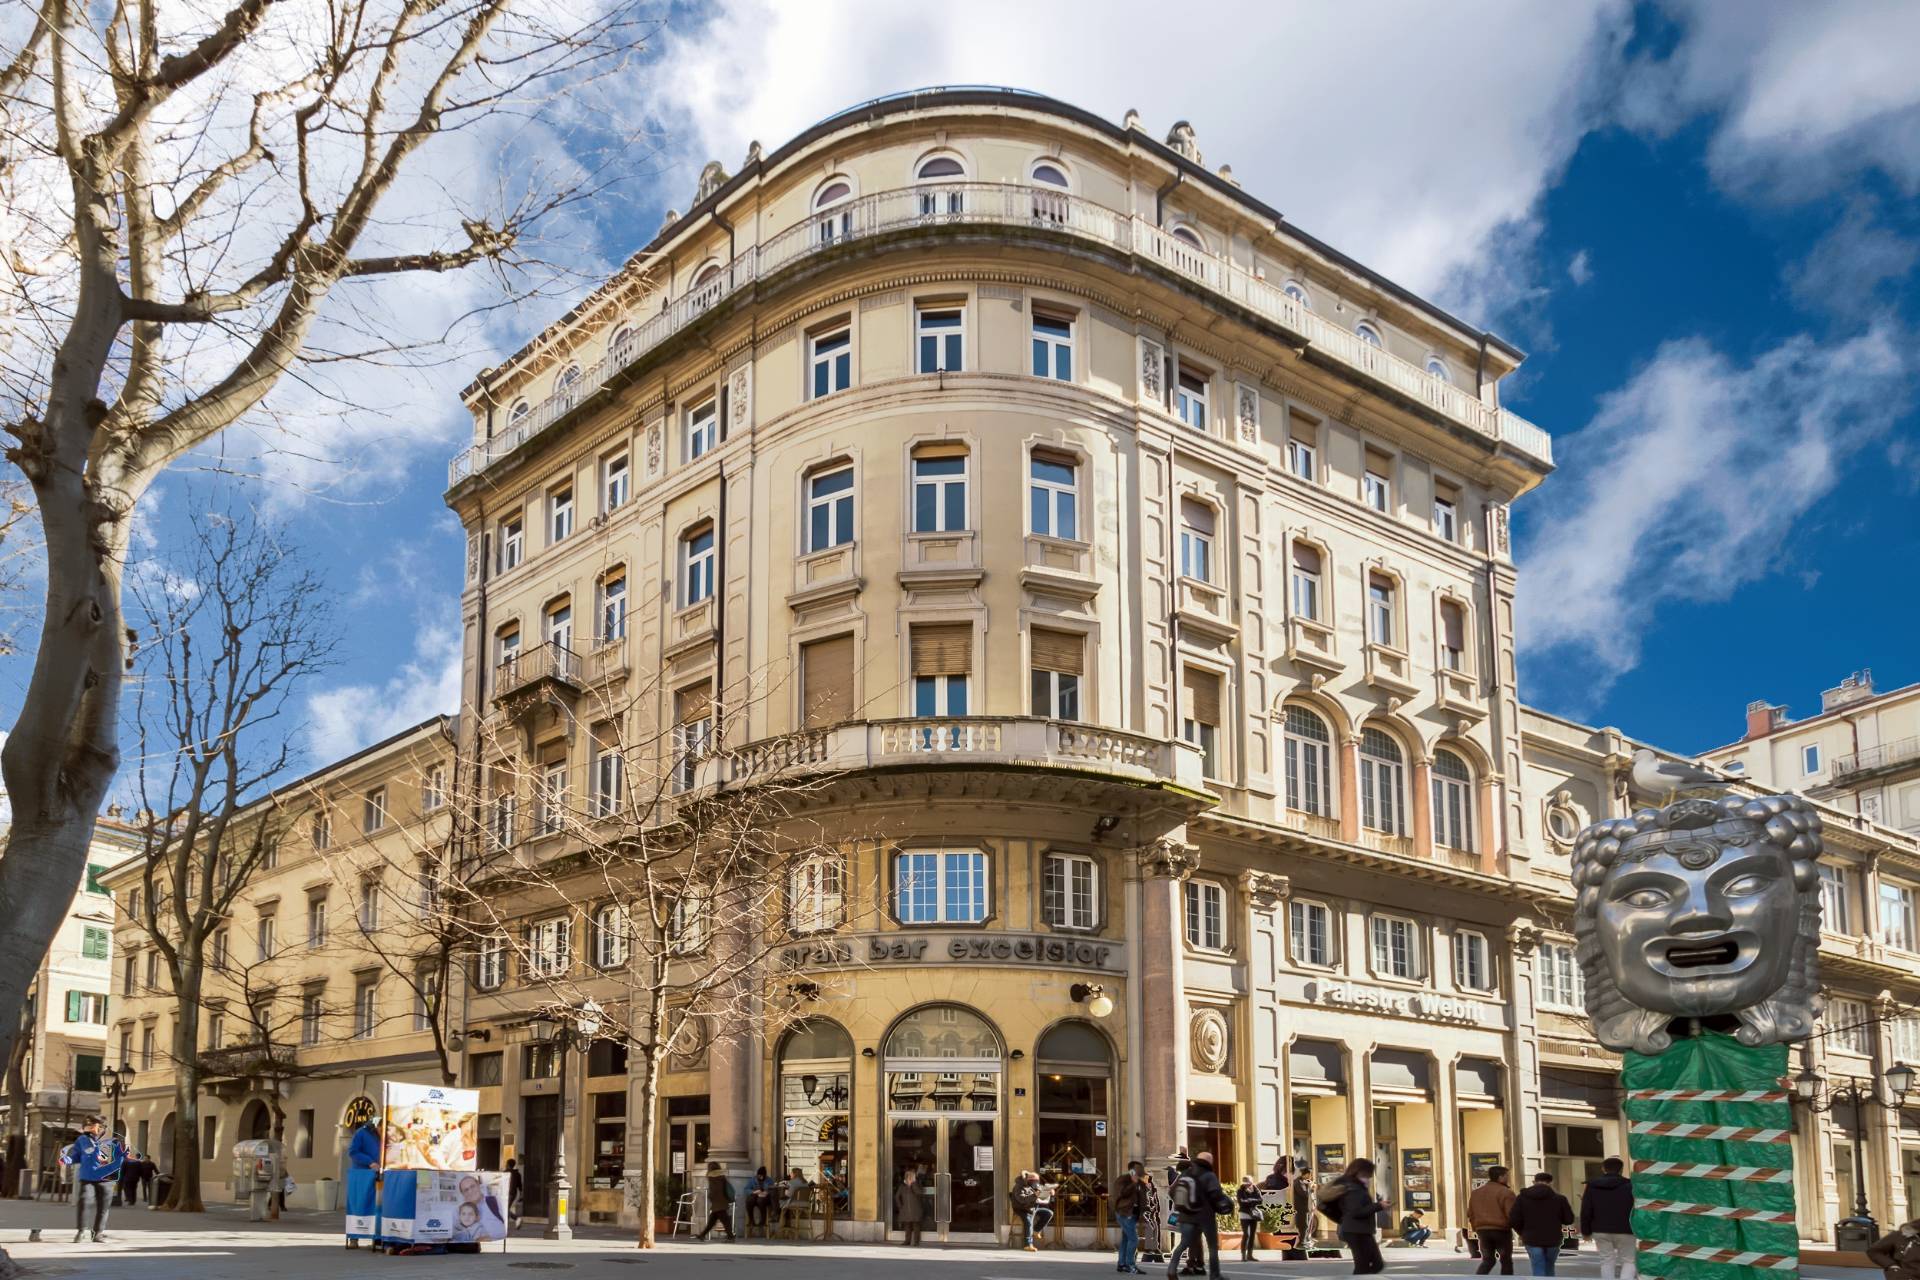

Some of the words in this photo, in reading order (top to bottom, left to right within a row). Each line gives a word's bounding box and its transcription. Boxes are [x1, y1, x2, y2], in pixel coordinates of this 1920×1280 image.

[780, 944, 852, 968] gran
[870, 935, 928, 960] bar
[947, 936, 1110, 965] excelsior
[1317, 978, 1410, 1012] Palestra
[1415, 992, 1487, 1021] Webfit
[345, 1100, 373, 1127] OTTIC
